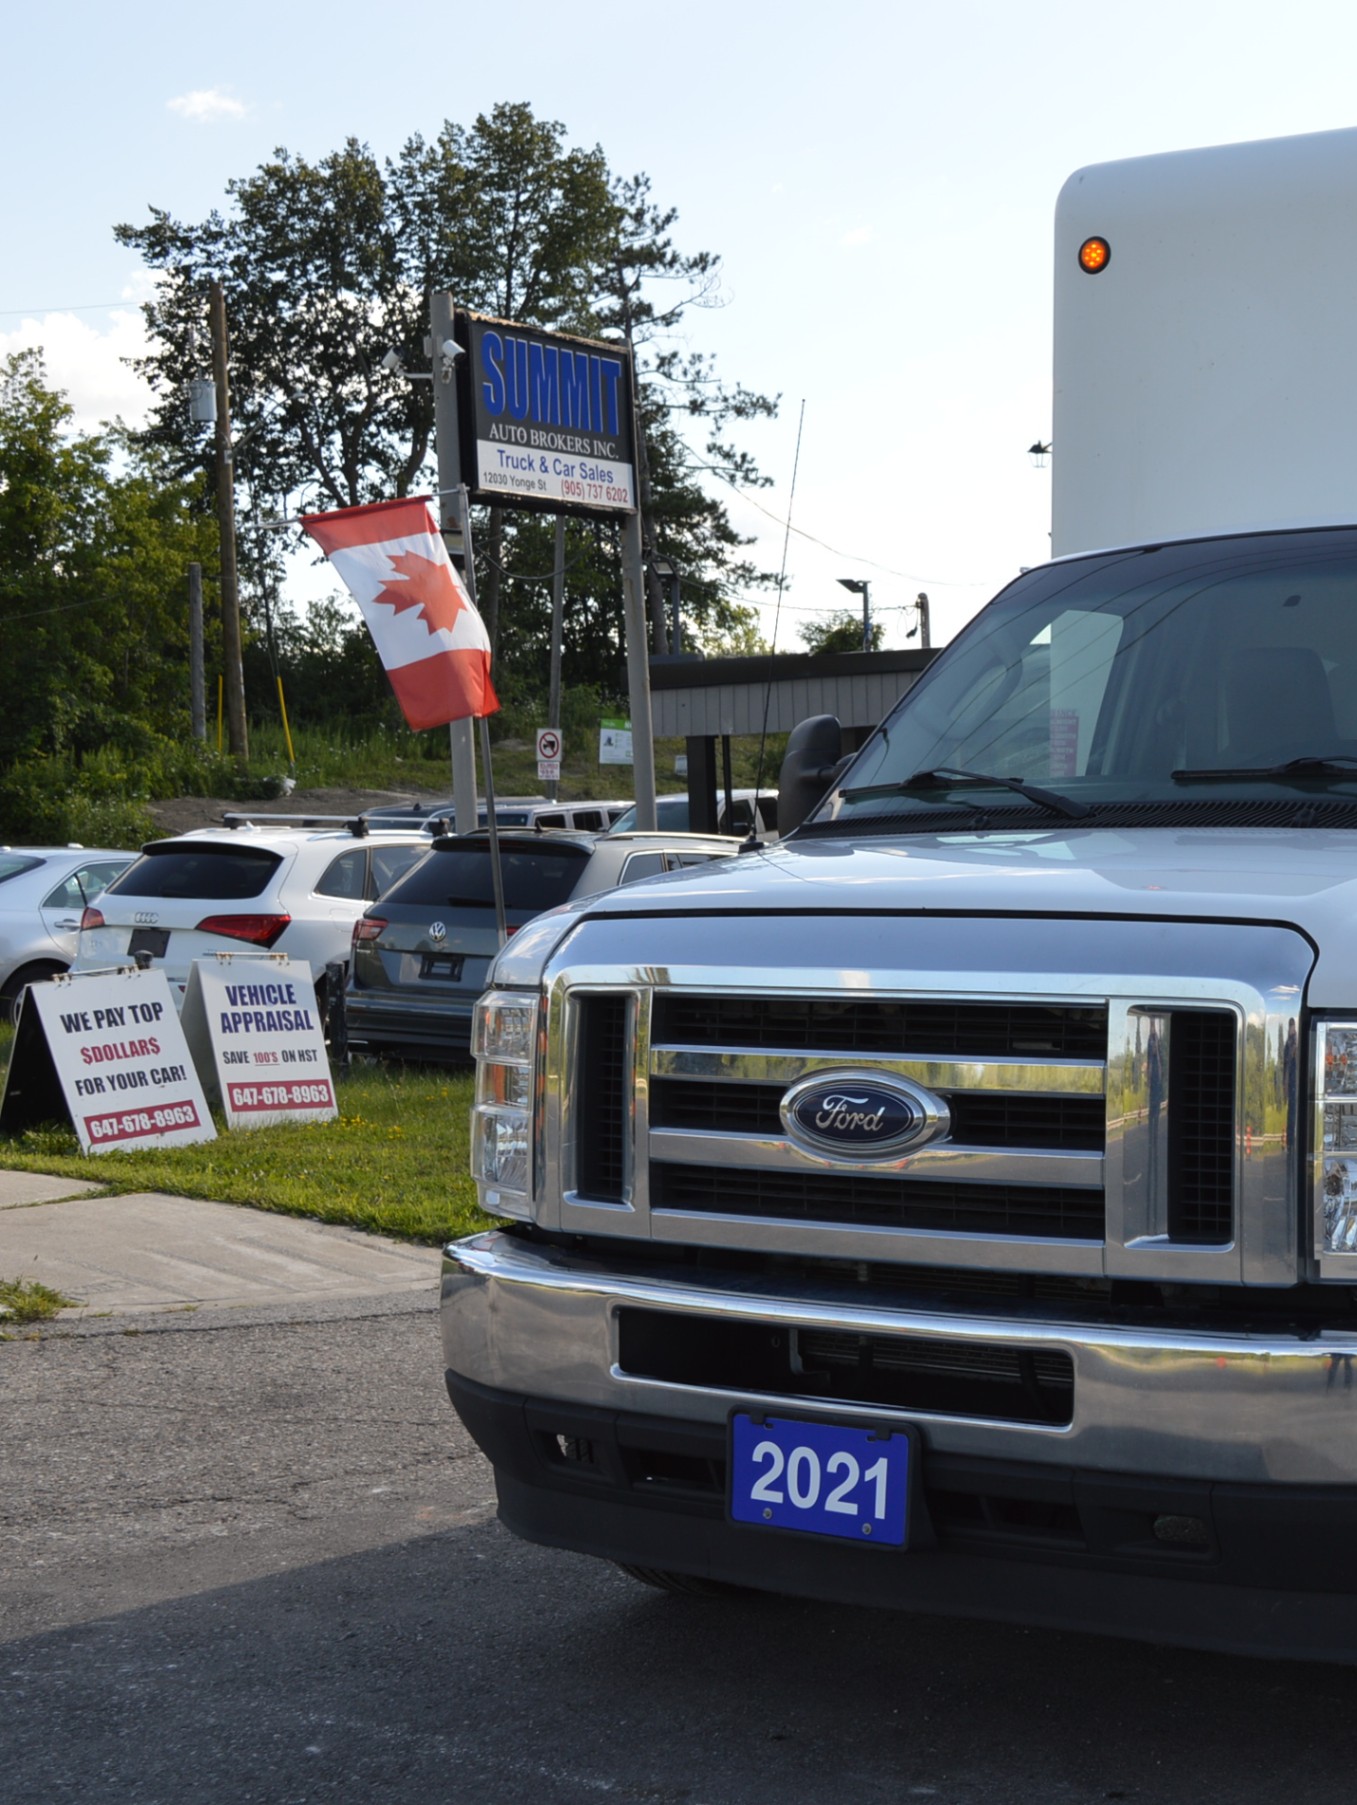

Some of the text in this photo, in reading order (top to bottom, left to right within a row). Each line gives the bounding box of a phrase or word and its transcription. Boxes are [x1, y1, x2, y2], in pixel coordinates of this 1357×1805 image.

[482, 330, 622, 437] SUMMIT
[489, 423, 619, 460] AUTO BROKERS INC.
[483, 471, 547, 492] 12030 Yonge St
[497, 449, 614, 484] Truck & Car Sales
[561, 479, 629, 504] (905) 737 6202
[225, 983, 297, 1007] VEHICLE
[60, 1001, 164, 1034] WE PAY TOP
[220, 1009, 314, 1035] APPRAISAL
[80, 1036, 161, 1066] $DOLLAR$
[222, 1049, 318, 1065] SAVE 100'S ON HST
[74, 1064, 188, 1097] FOR YOUR CAR!
[232, 1083, 330, 1106] 647-678-8963
[89, 1105, 196, 1139] 647-678-8963
[815, 1094, 886, 1132] Ford
[750, 1440, 888, 1520] 2021
